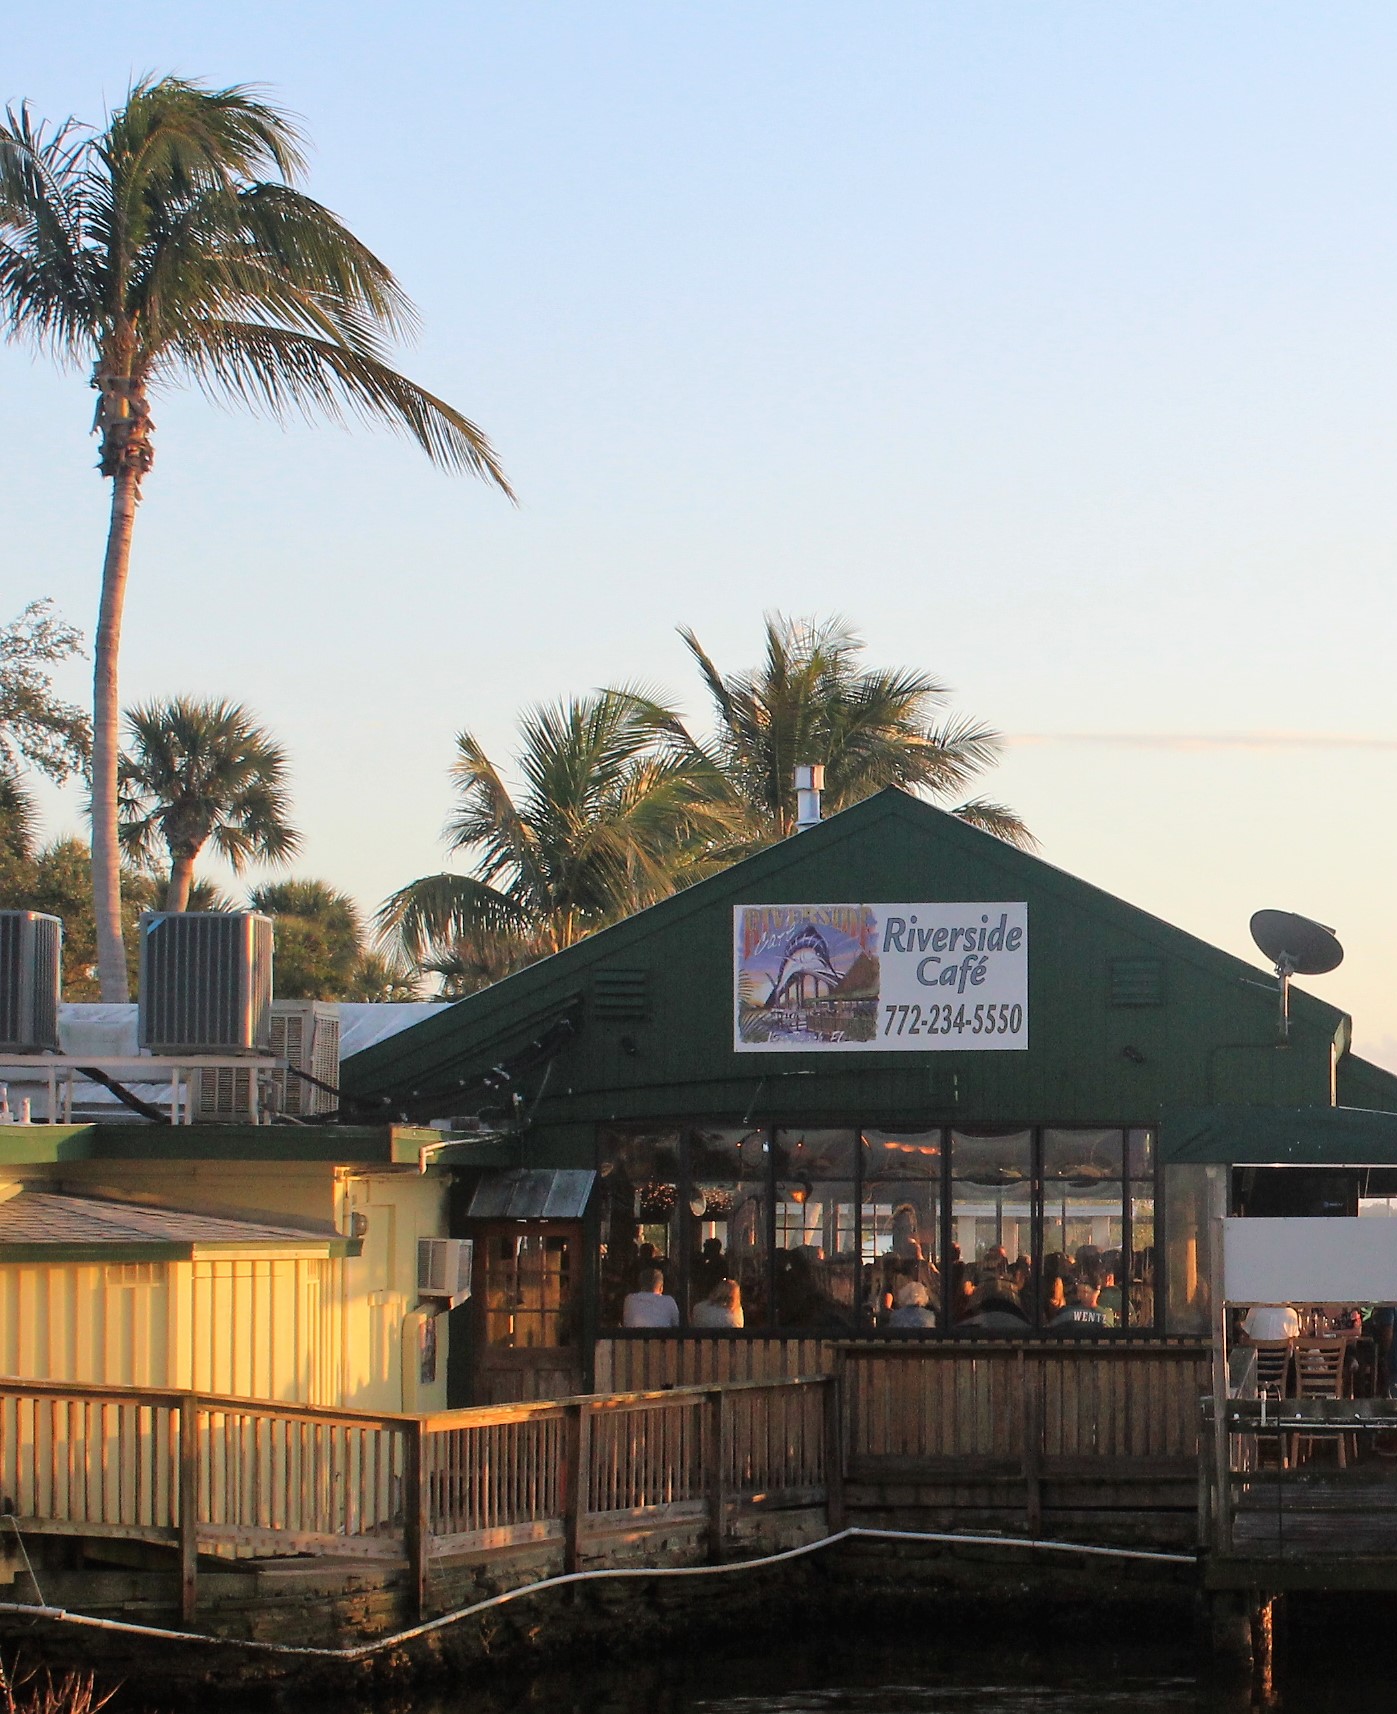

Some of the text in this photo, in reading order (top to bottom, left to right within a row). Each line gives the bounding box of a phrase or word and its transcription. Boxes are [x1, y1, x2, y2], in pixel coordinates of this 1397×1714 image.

[882, 913, 1023, 952] Riverside
[916, 953, 989, 994] Café
[884, 1003, 1023, 1036] 772-234-5550
